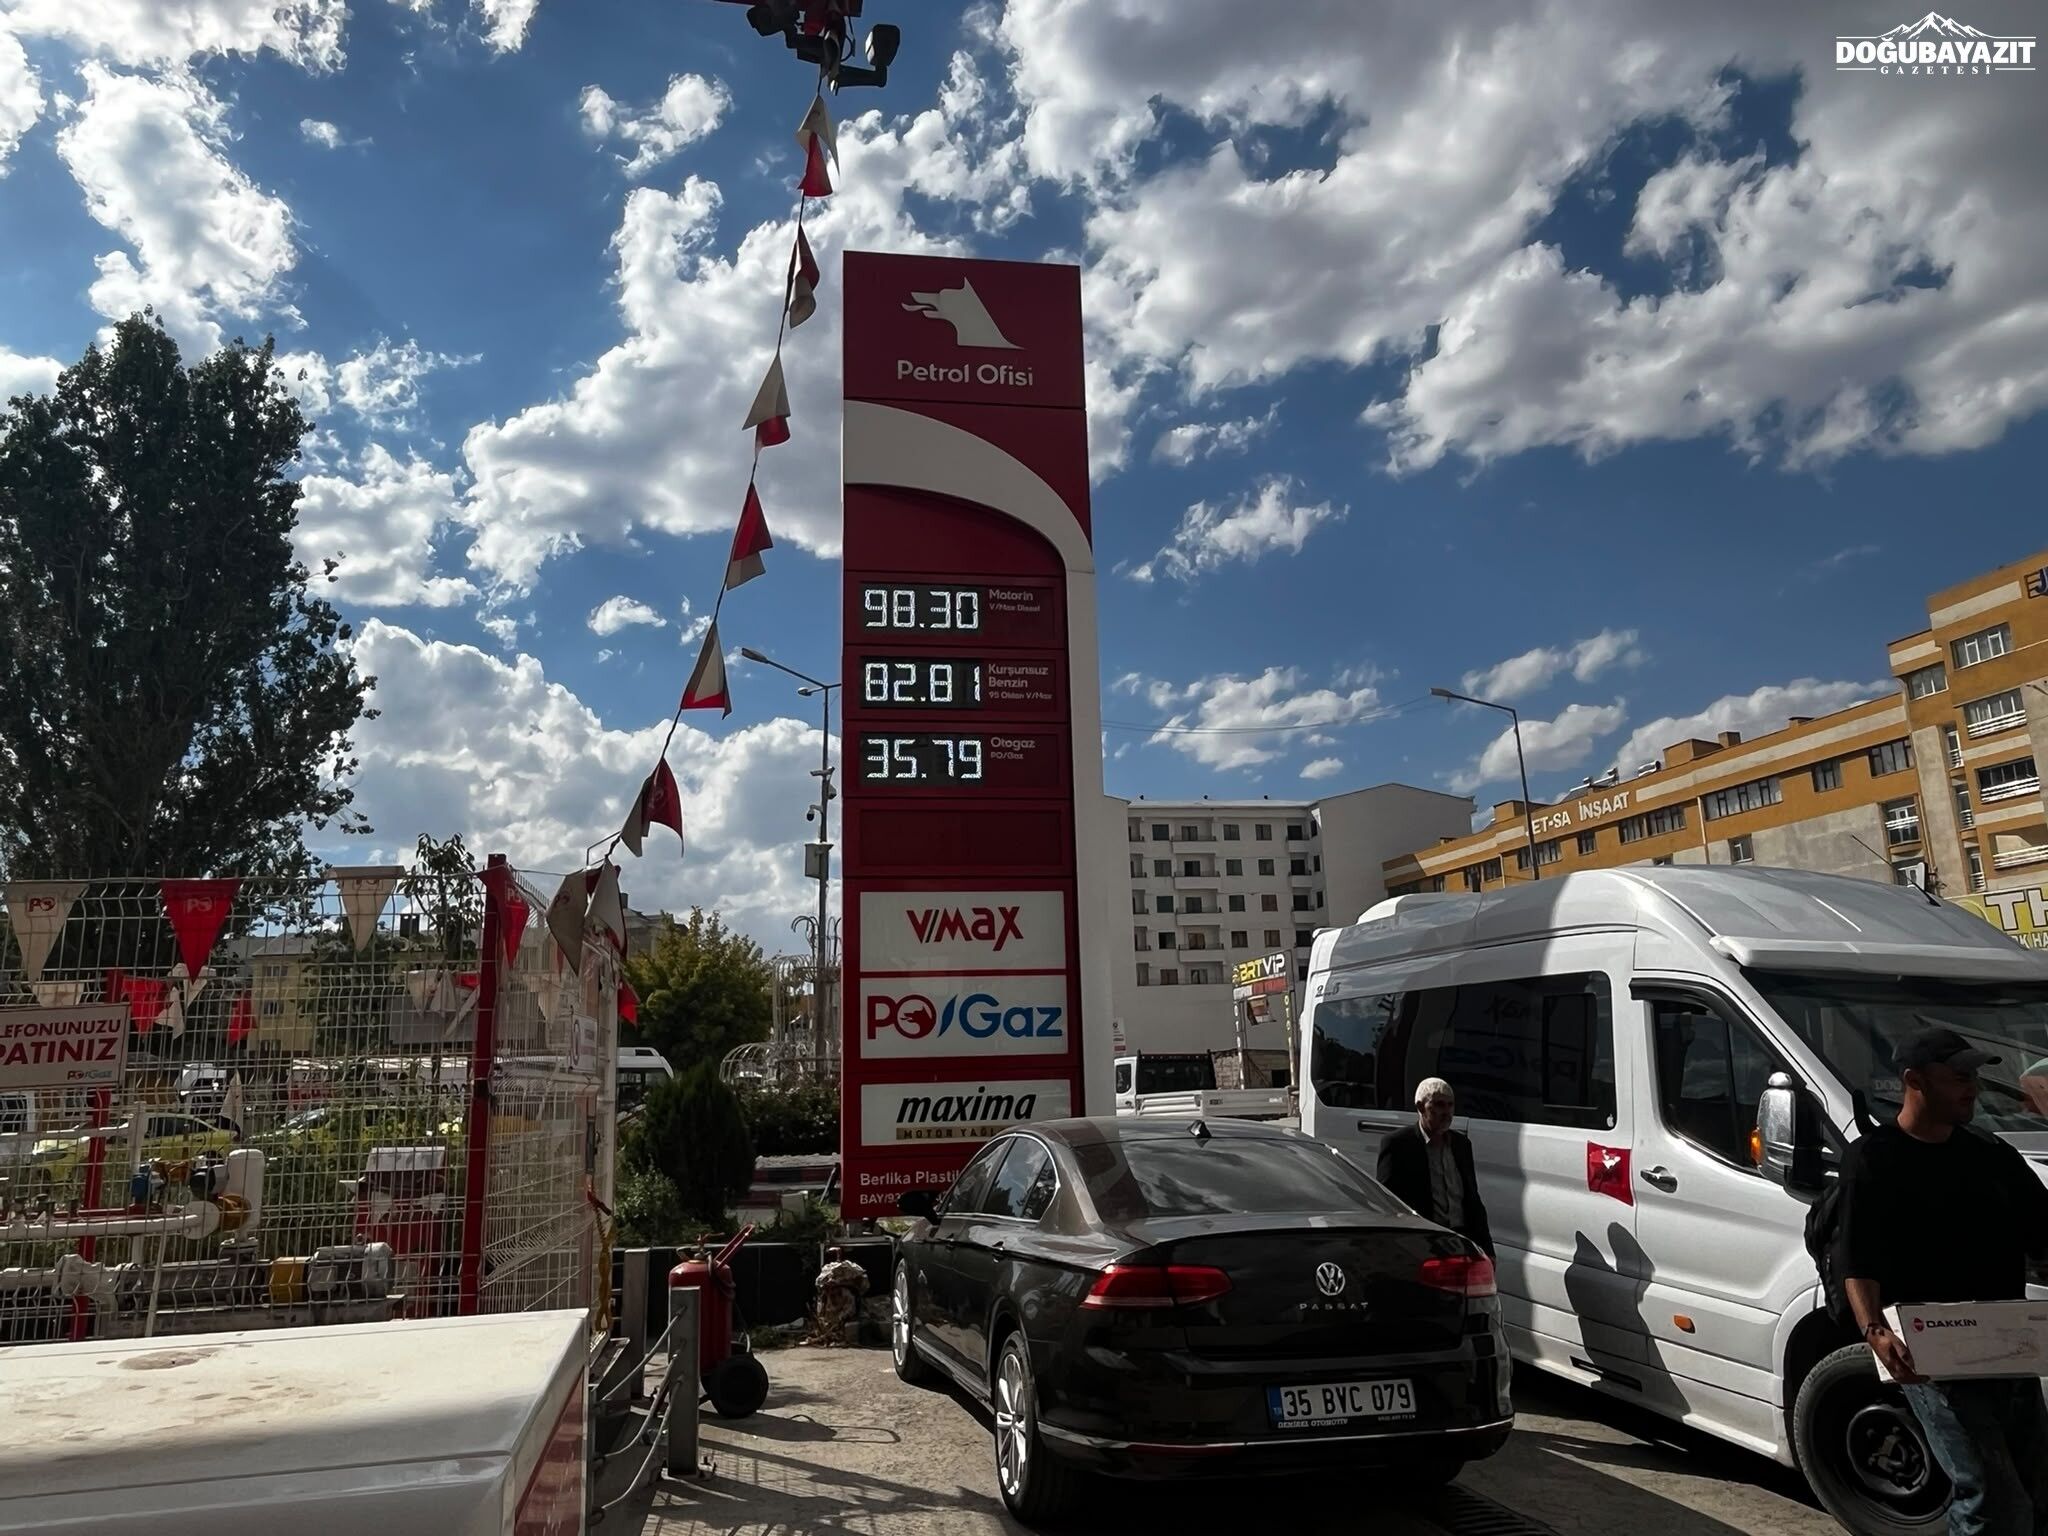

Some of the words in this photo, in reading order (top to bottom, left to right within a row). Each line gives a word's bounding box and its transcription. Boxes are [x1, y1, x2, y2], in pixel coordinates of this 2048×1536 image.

[897, 359, 970, 383] Petrol
[976, 364, 1033, 386] Ofisi
[989, 589, 1033, 601] Motorin
[865, 589, 979, 629] 98.30
[988, 664, 1049, 677] Kurşunsuz
[865, 663, 981, 702] 82.81
[988, 677, 1028, 689] Benzin
[990, 737, 1035, 751] Otogaz
[867, 739, 982, 779] 35.79
[1525, 811, 1571, 837] ET-SA
[896, 1085, 1037, 1123] maxima
[904, 1128, 953, 1139] MOTOR
[860, 1172, 911, 1186] Berlika
[1299, 1302, 1369, 1311] PASSAT
[1284, 1389, 1312, 1417] 35
[1322, 1386, 1363, 1415] BVC
[1371, 1383, 1411, 1412] 079
